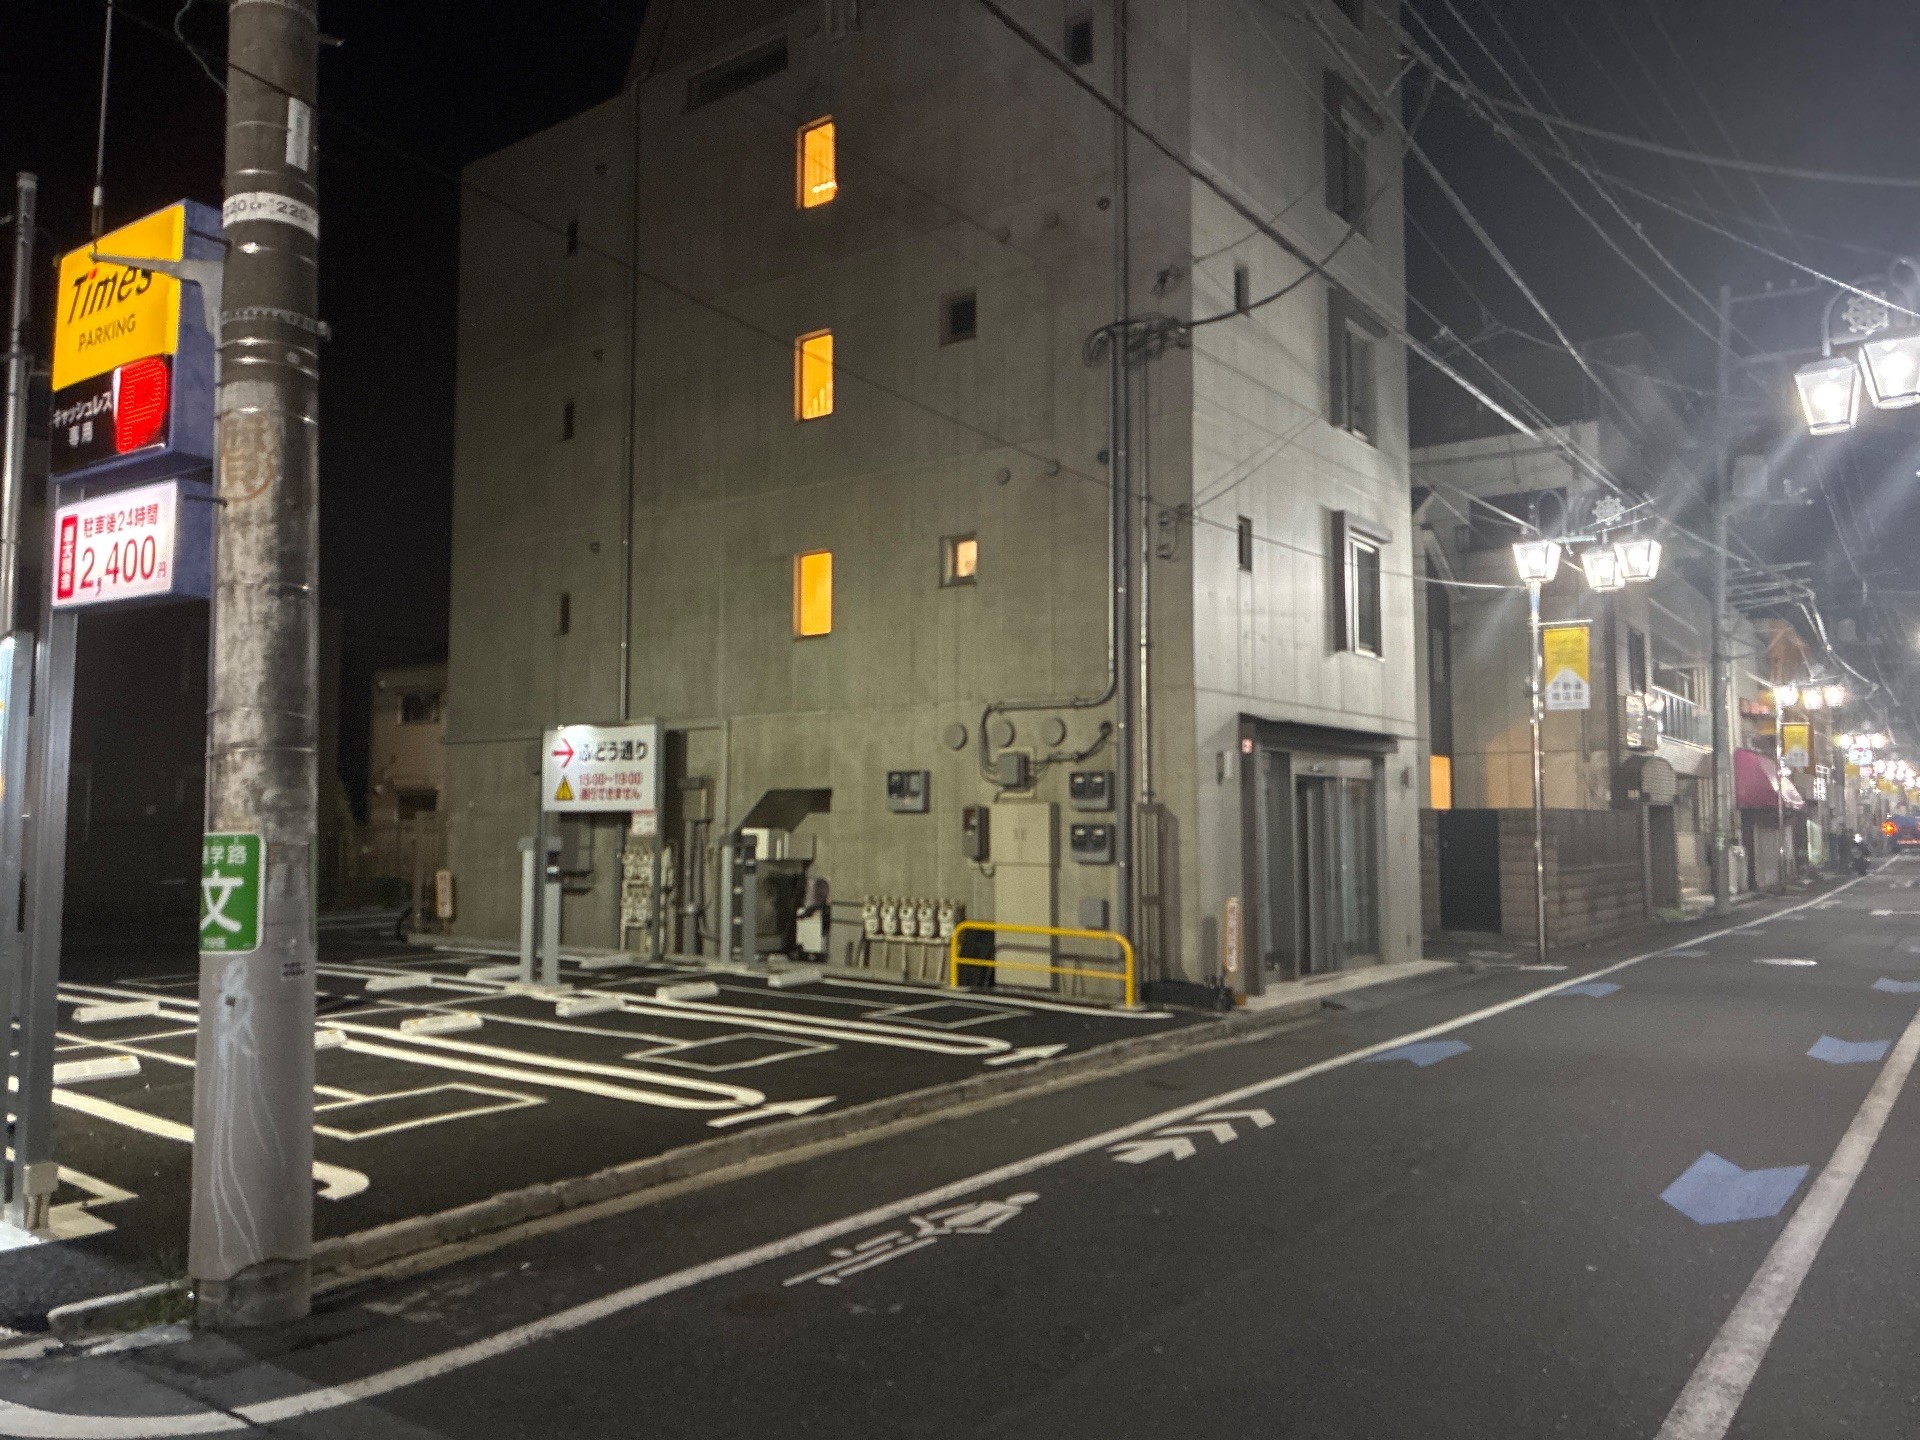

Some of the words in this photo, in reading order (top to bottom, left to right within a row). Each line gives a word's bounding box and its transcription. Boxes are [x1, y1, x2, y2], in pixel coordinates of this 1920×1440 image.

[67, 265, 153, 325] Times
[78, 313, 137, 352] PARKING
[52, 391, 112, 429] キャッシュレス
[83, 503, 159, 538] 駐車後24時間
[579, 740, 649, 762] ふどう通り
